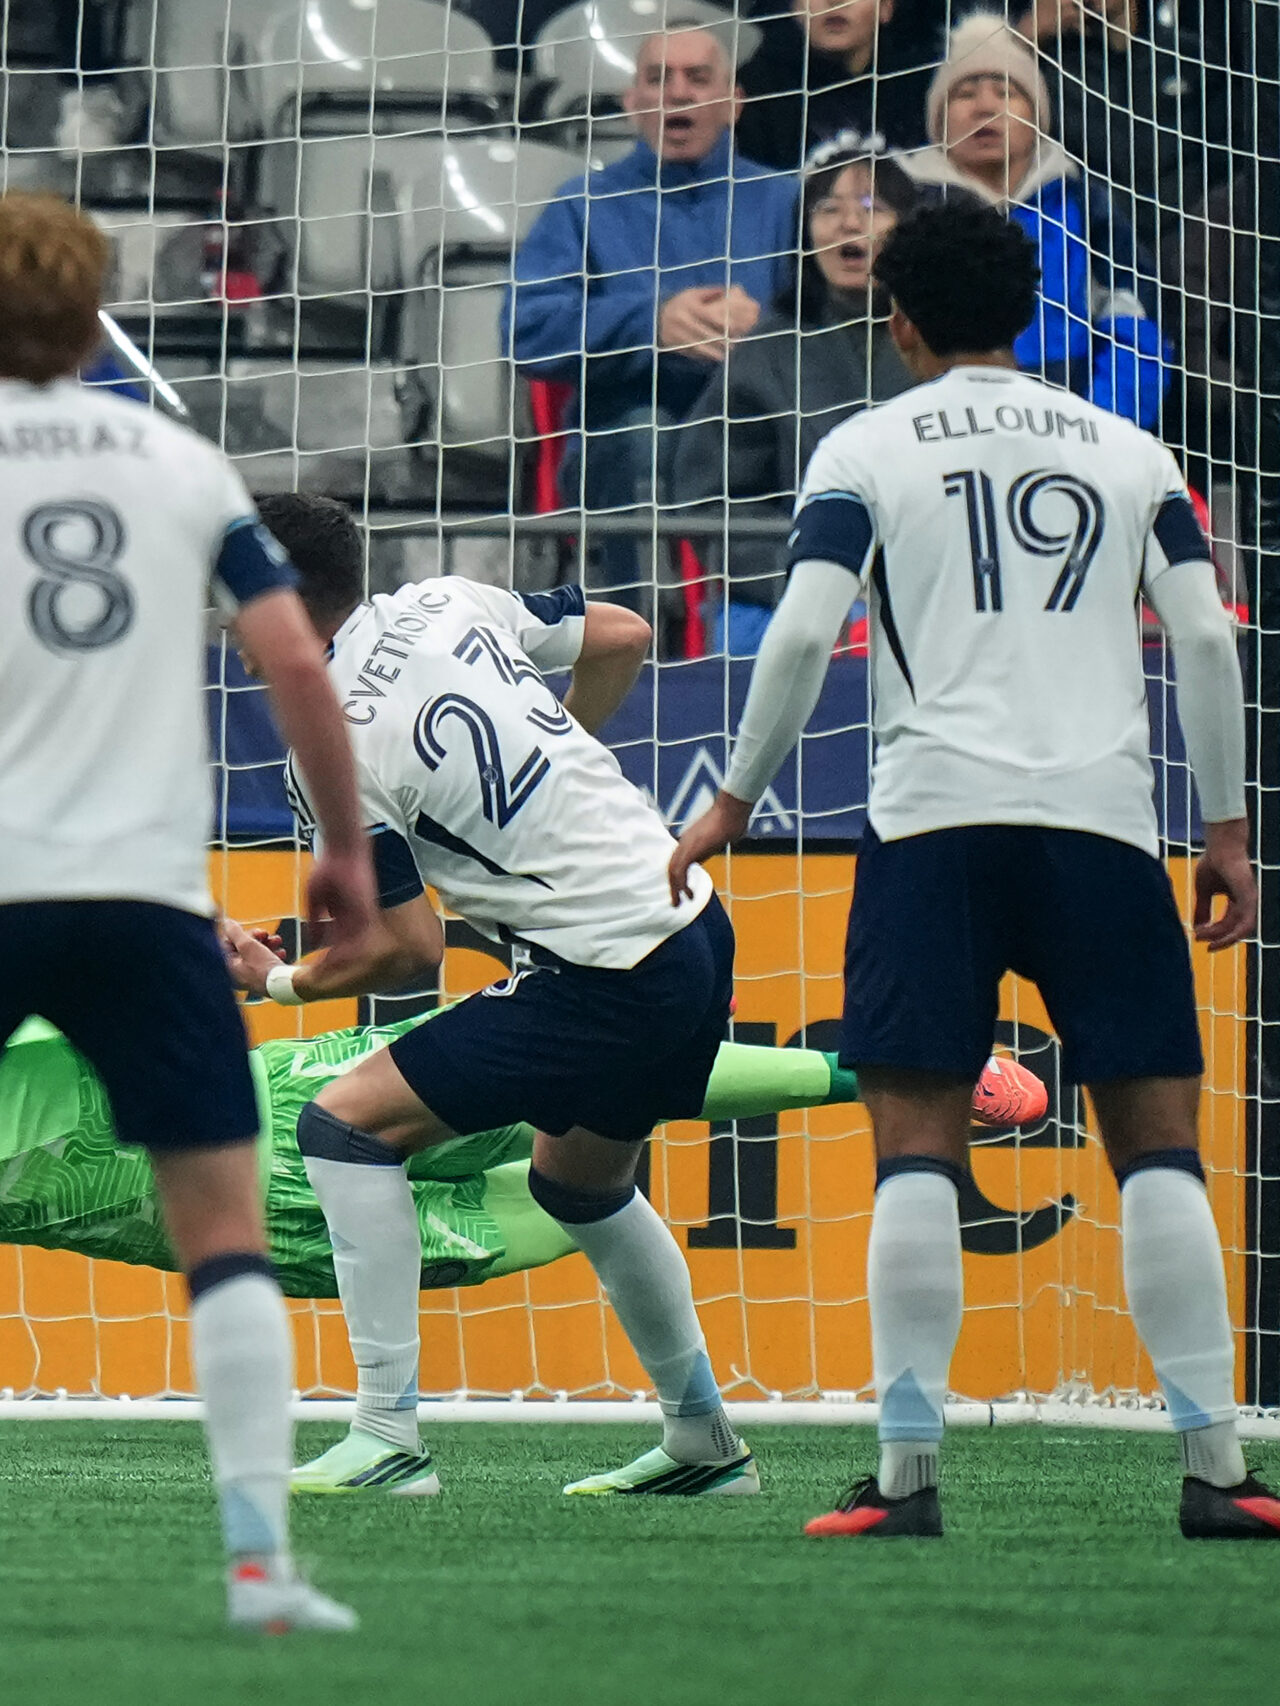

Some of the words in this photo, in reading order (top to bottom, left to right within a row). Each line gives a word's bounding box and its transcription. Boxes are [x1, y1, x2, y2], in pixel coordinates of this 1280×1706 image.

[912, 405, 1099, 445] ELLOUMI
[21, 497, 136, 655] 8
[941, 467, 1106, 614] 19
[412, 626, 574, 831] 23
